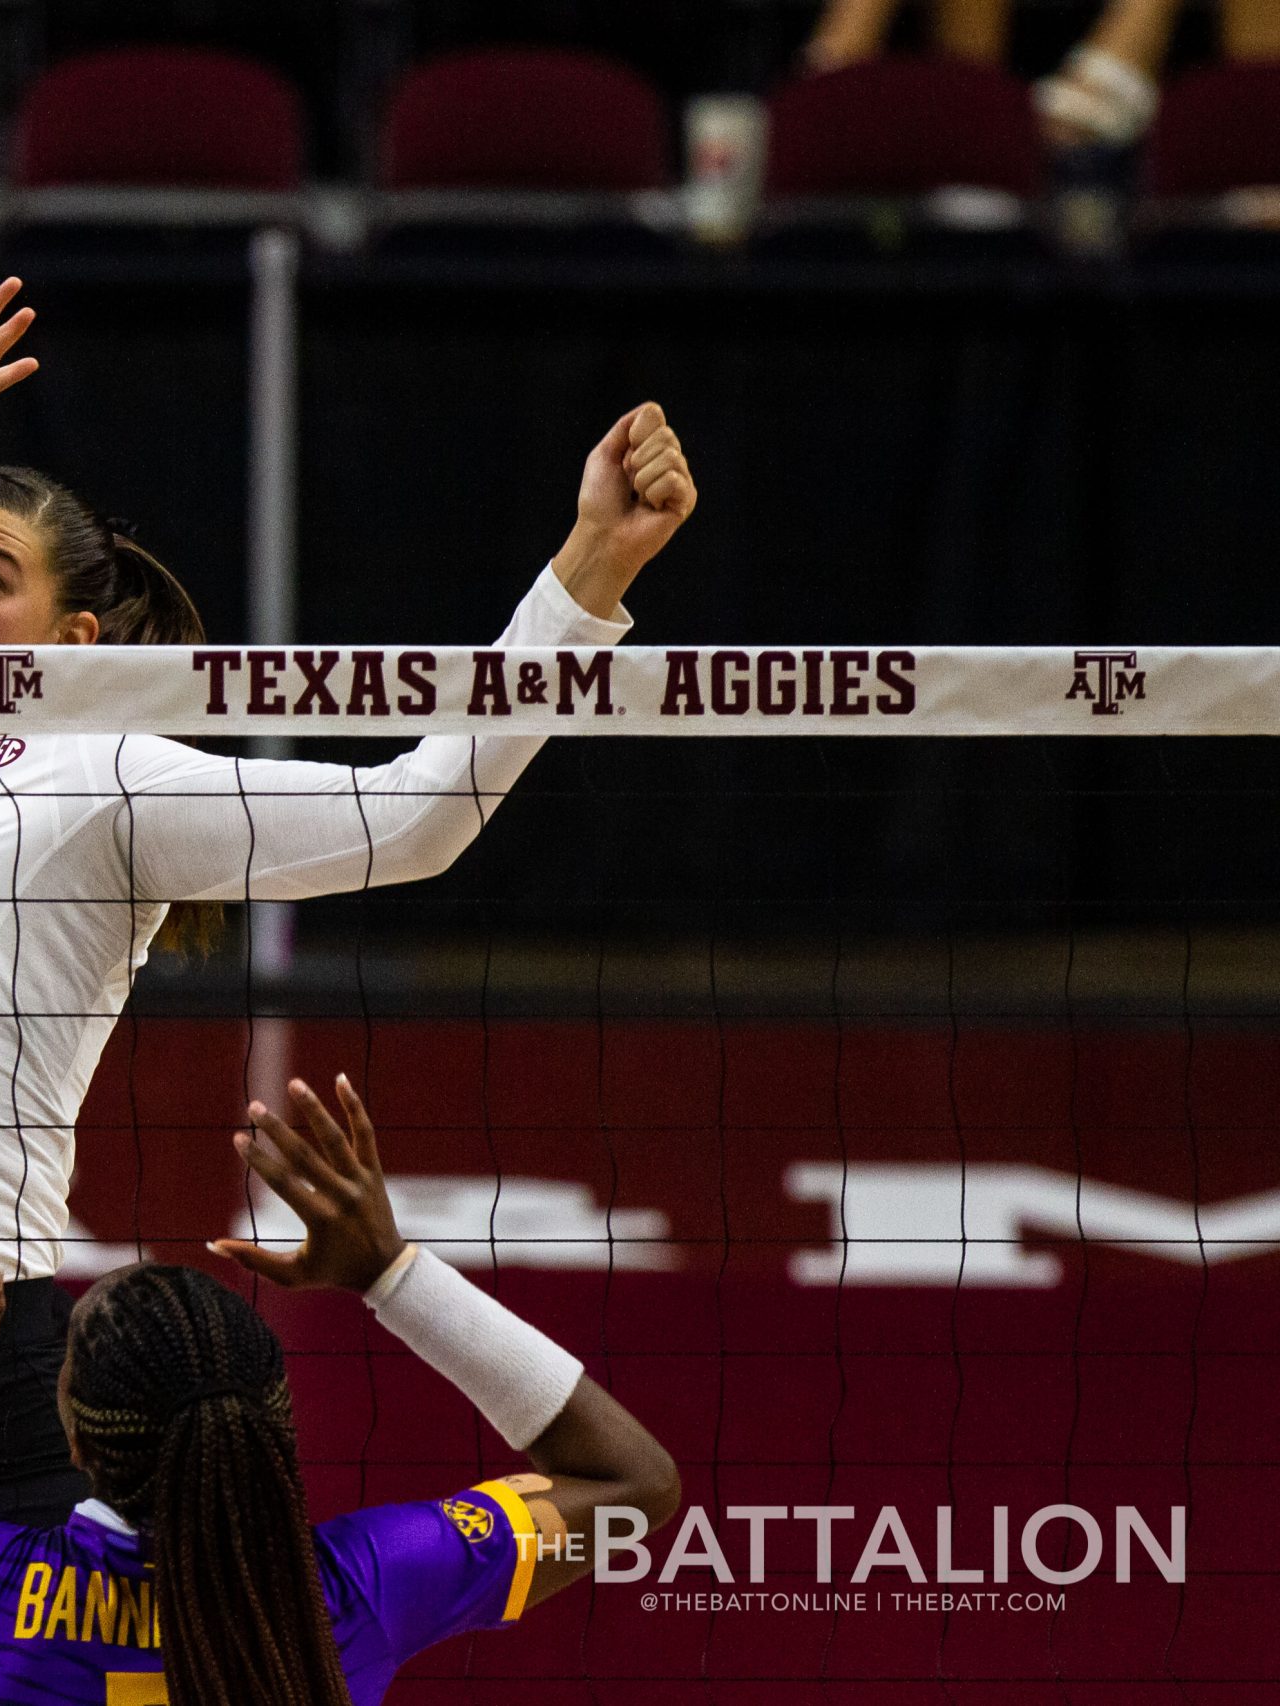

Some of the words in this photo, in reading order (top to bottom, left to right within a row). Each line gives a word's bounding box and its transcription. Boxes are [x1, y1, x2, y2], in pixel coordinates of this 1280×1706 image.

[192, 650, 437, 716] TEXAS
[466, 650, 614, 716] A&M
[659, 650, 917, 716] AGGIES
[13, 1562, 162, 1649] BANN
